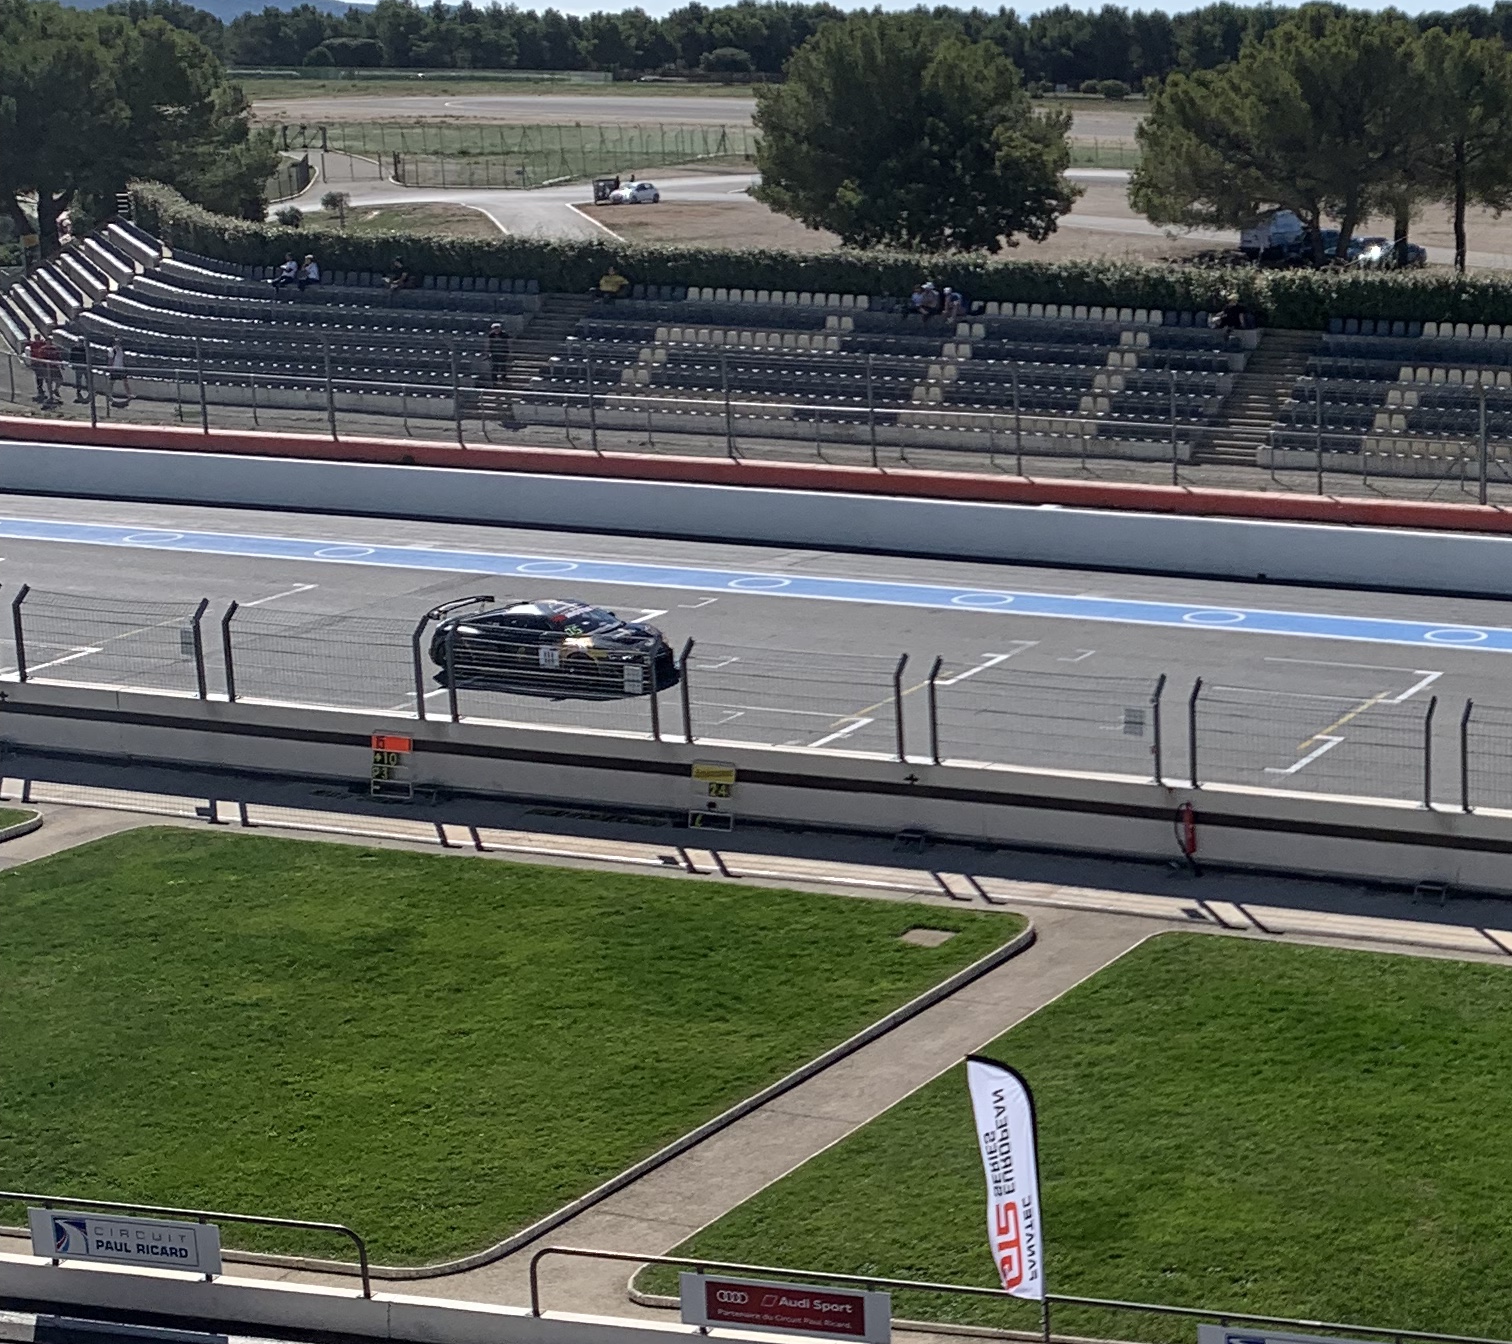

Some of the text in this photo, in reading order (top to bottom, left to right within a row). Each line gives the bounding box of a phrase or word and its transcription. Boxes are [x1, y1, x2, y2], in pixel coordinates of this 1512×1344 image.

[94, 1226, 187, 1243] CIRCUIT
[96, 1239, 188, 1259] PAUL RICARD
[779, 1296, 853, 1314] Audi Sport
